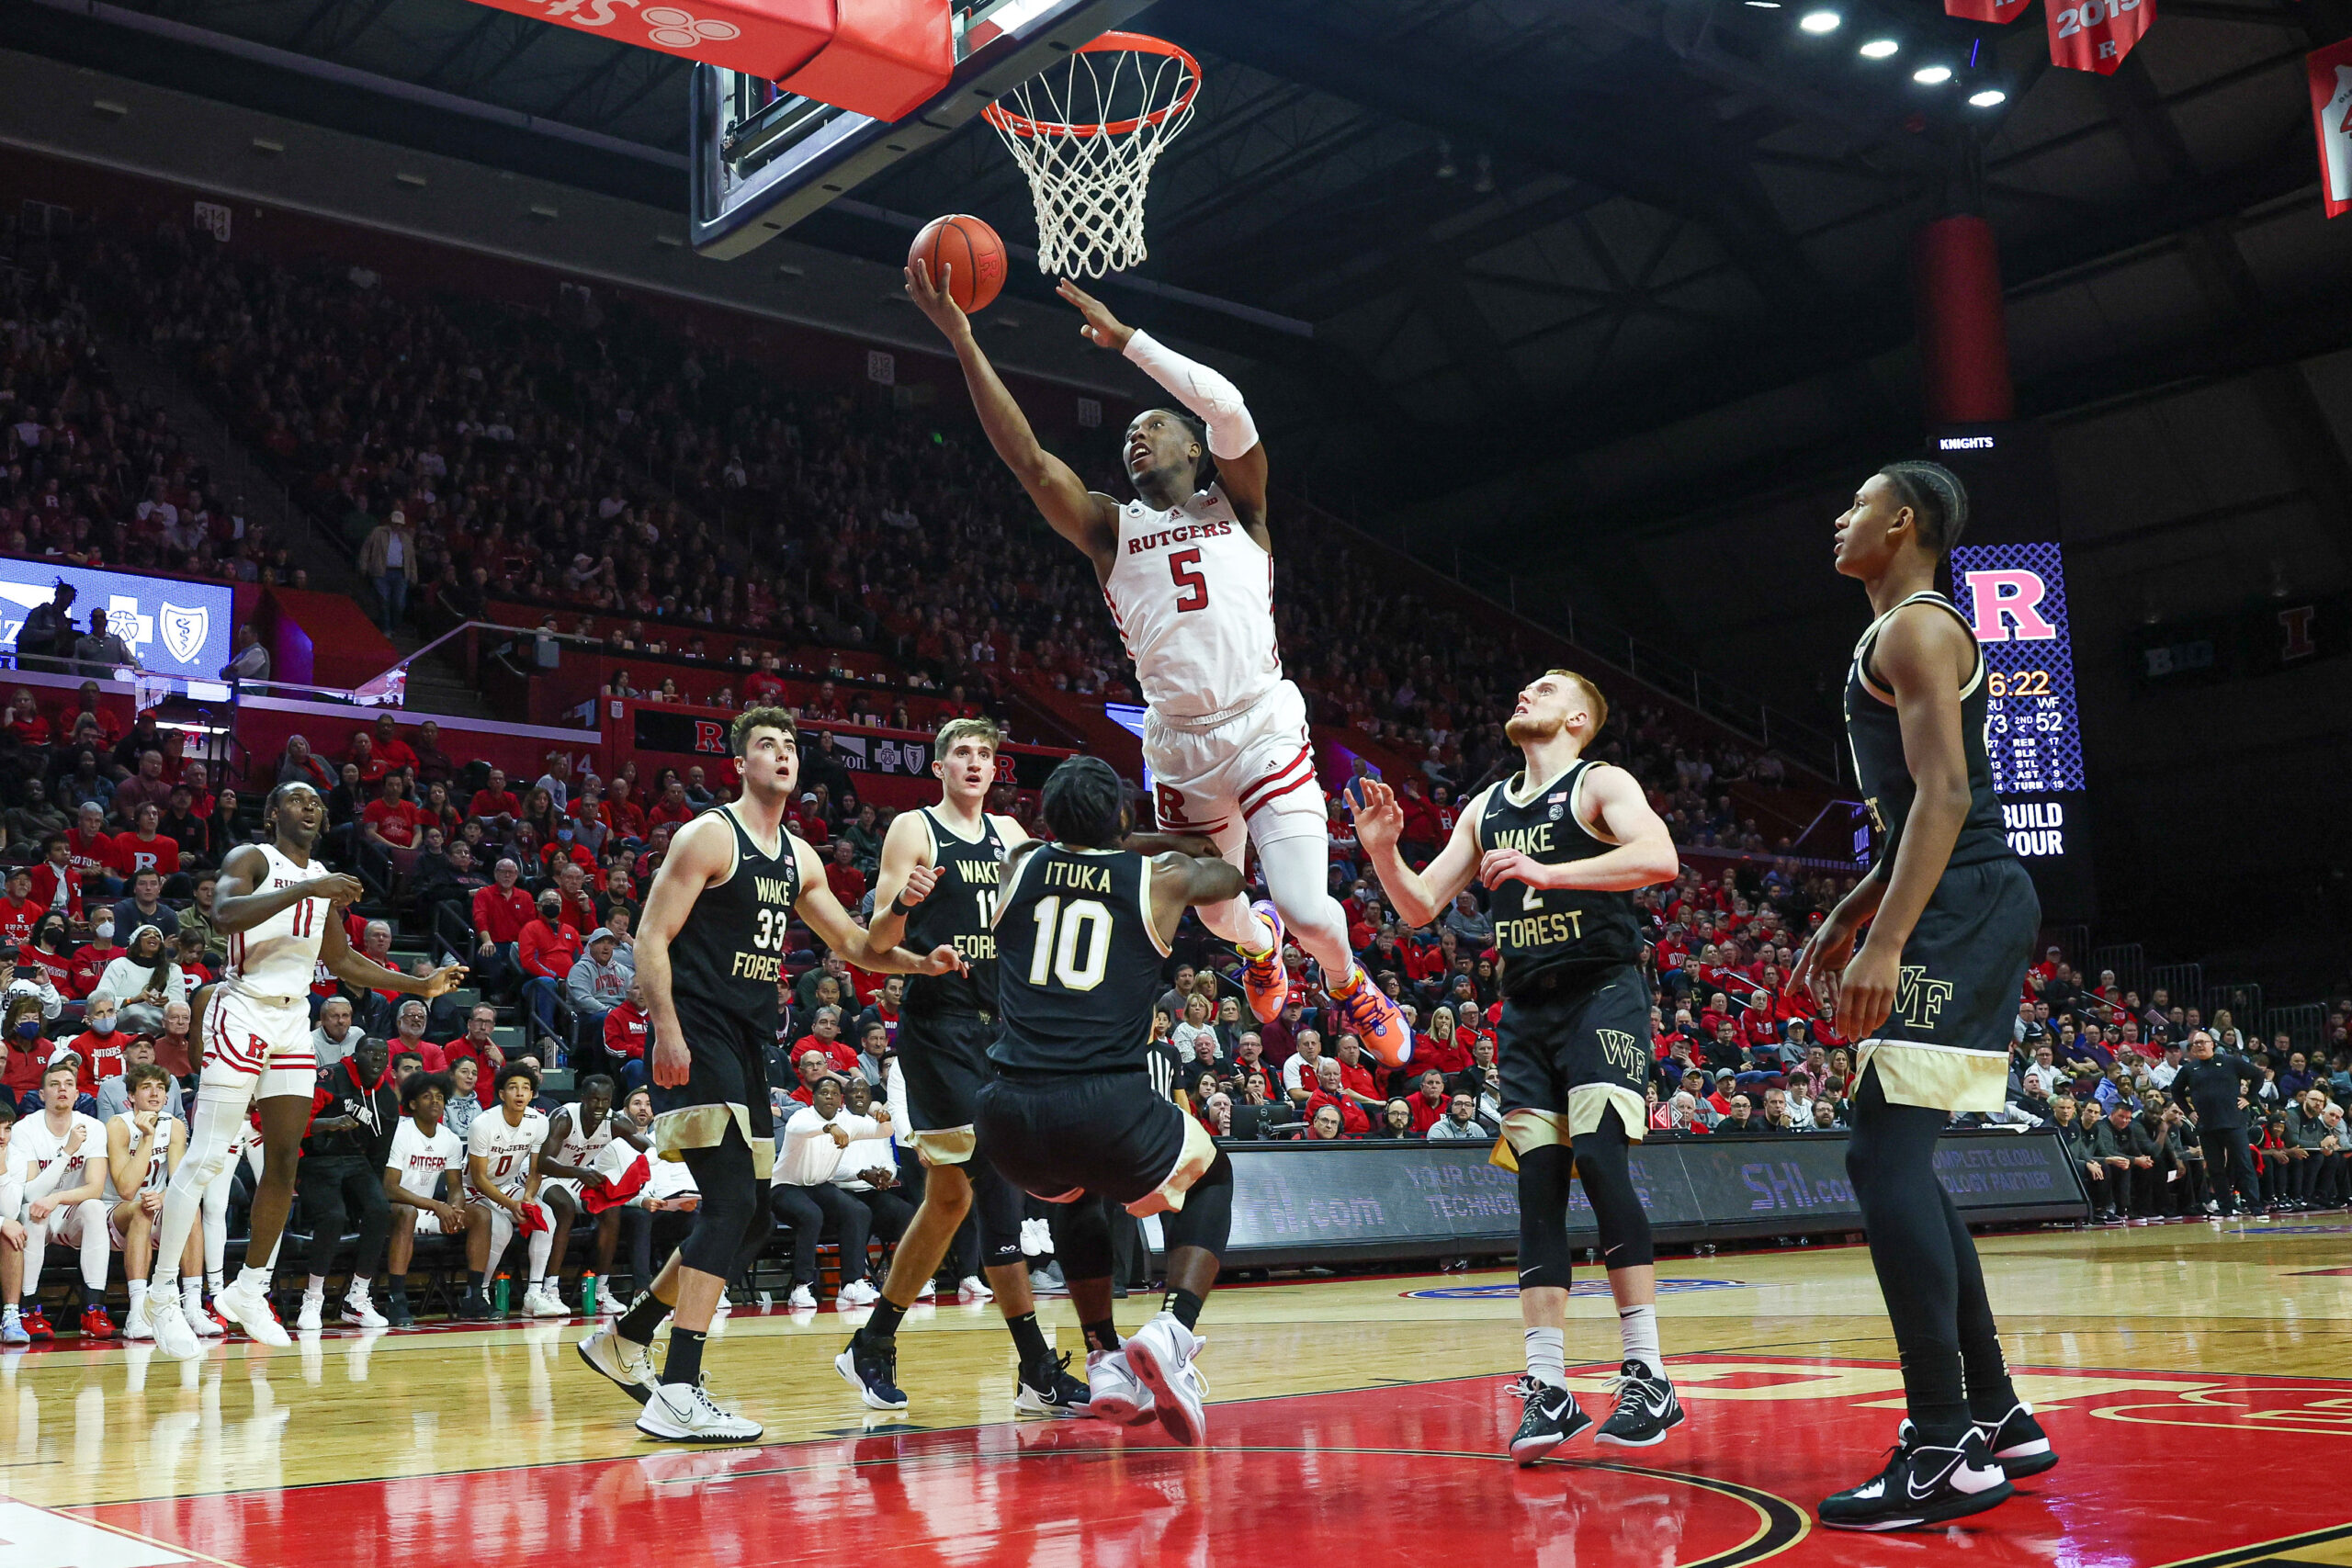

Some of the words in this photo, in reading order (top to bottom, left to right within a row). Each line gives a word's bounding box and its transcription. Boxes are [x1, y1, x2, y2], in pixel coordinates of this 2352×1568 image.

[2098, 39, 2118, 60] R
[1939, 437, 1994, 449] KNIGHTS
[1128, 521, 1232, 555] RUTGERS
[1169, 548, 1208, 613] 5
[1964, 569, 2057, 643] R
[1988, 671, 2051, 697] 6:22
[2037, 697, 2059, 709] WF
[2015, 716, 2033, 725] 2ND
[2035, 712, 2063, 732] 52
[695, 721, 726, 753] R
[2012, 739, 2036, 747] REB
[2048, 738, 2060, 746] 17
[1991, 761, 2001, 770] 13
[2014, 749, 2037, 758] BLK
[994, 754, 1017, 784] R
[2017, 771, 2039, 779] AST
[2013, 781, 2043, 791] TURN
[2052, 781, 2064, 789] 19
[1157, 782, 1189, 822] R
[2002, 802, 2064, 829] BUILD
[1494, 822, 1555, 855] WAKE
[2005, 829, 2065, 856] YOUR
[134, 852, 158, 874] R
[754, 875, 791, 907] WAKE
[1045, 861, 1112, 894] ITUKA
[293, 897, 314, 938] 11
[753, 908, 787, 952] 33
[1495, 909, 1582, 950] FOREST
[954, 935, 999, 960] FORE
[1029, 895, 1114, 992] 10
[732, 951, 783, 983] FORES
[93, 1045, 121, 1057] RUTGERS
[246, 1032, 268, 1060] R
[1596, 1028, 1646, 1085] WF
[494, 1155, 514, 1178] 0
[1932, 1149, 1997, 1169] OMPLETE
[1996, 1148, 2051, 1167] GLOBAL
[1403, 1164, 1467, 1189] YOUR
[1990, 1171, 2054, 1191] PARTNER
